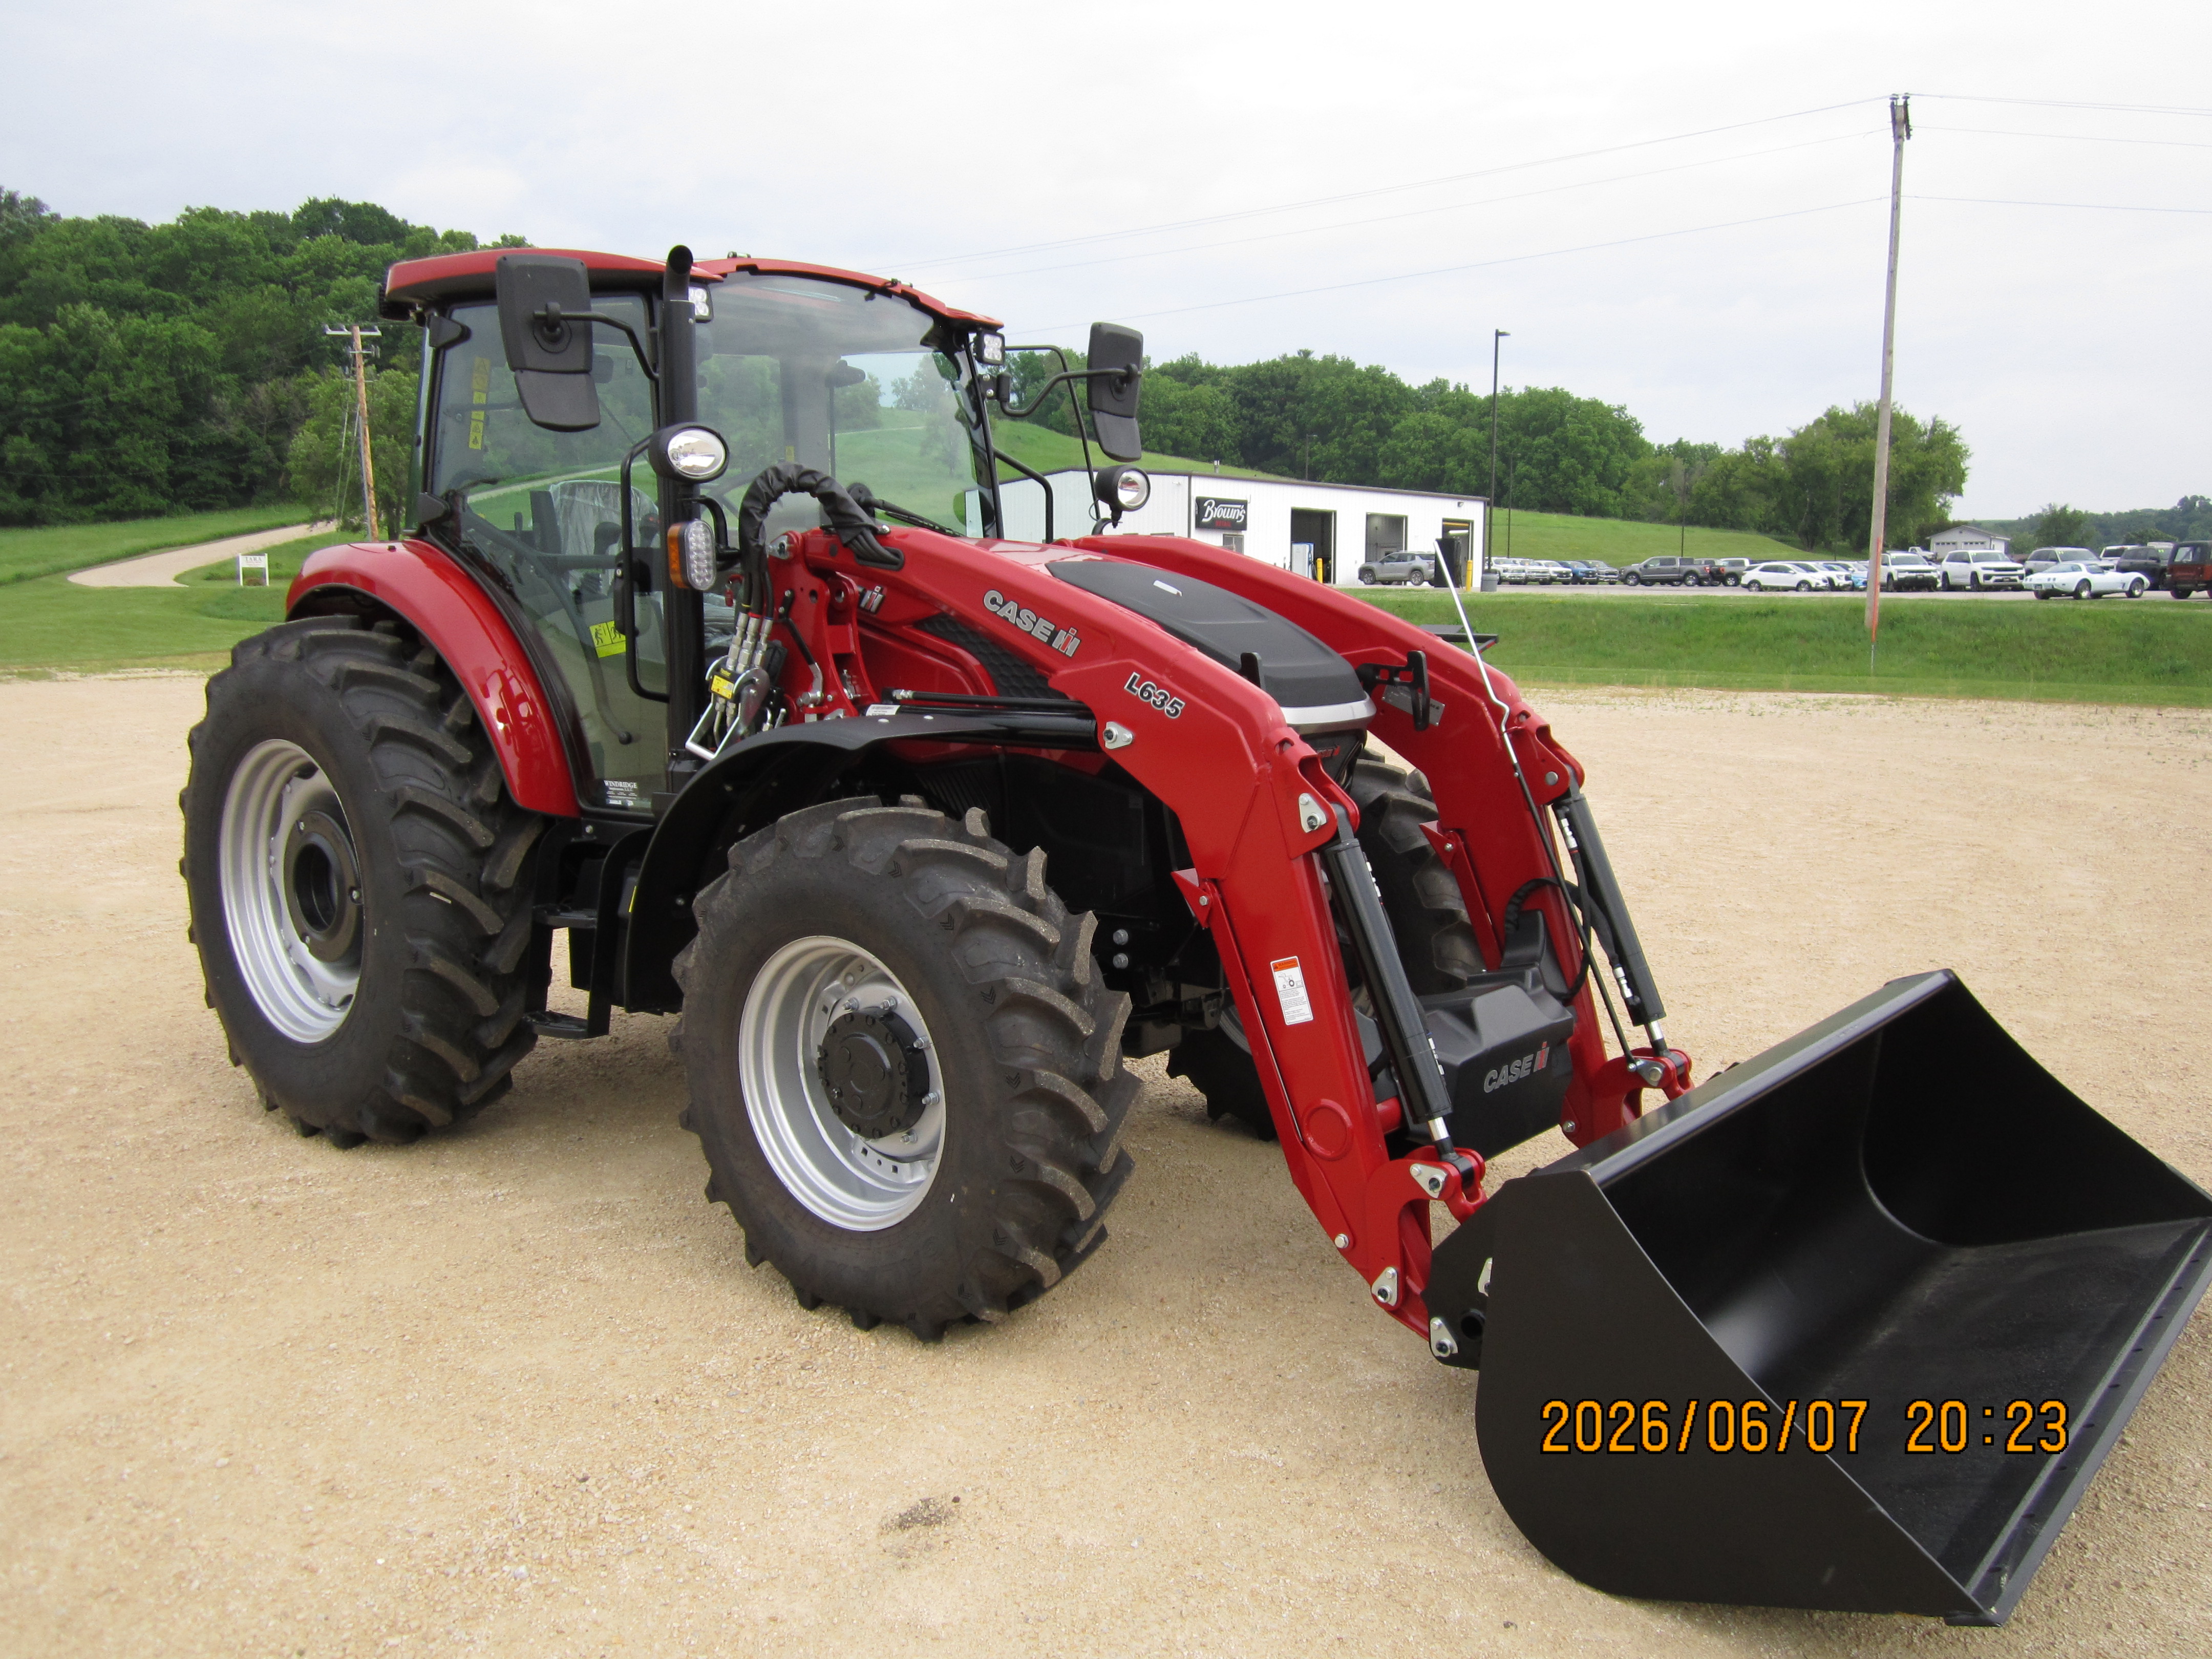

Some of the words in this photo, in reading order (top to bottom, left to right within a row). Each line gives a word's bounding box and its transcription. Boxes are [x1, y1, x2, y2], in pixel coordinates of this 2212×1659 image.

[1202, 499, 1246, 523] Brown's
[983, 589, 1055, 643] CASE
[1124, 672, 1186, 719] L635
[604, 780, 637, 789] WINDRIDGE
[1484, 1054, 1534, 1093] CASE
